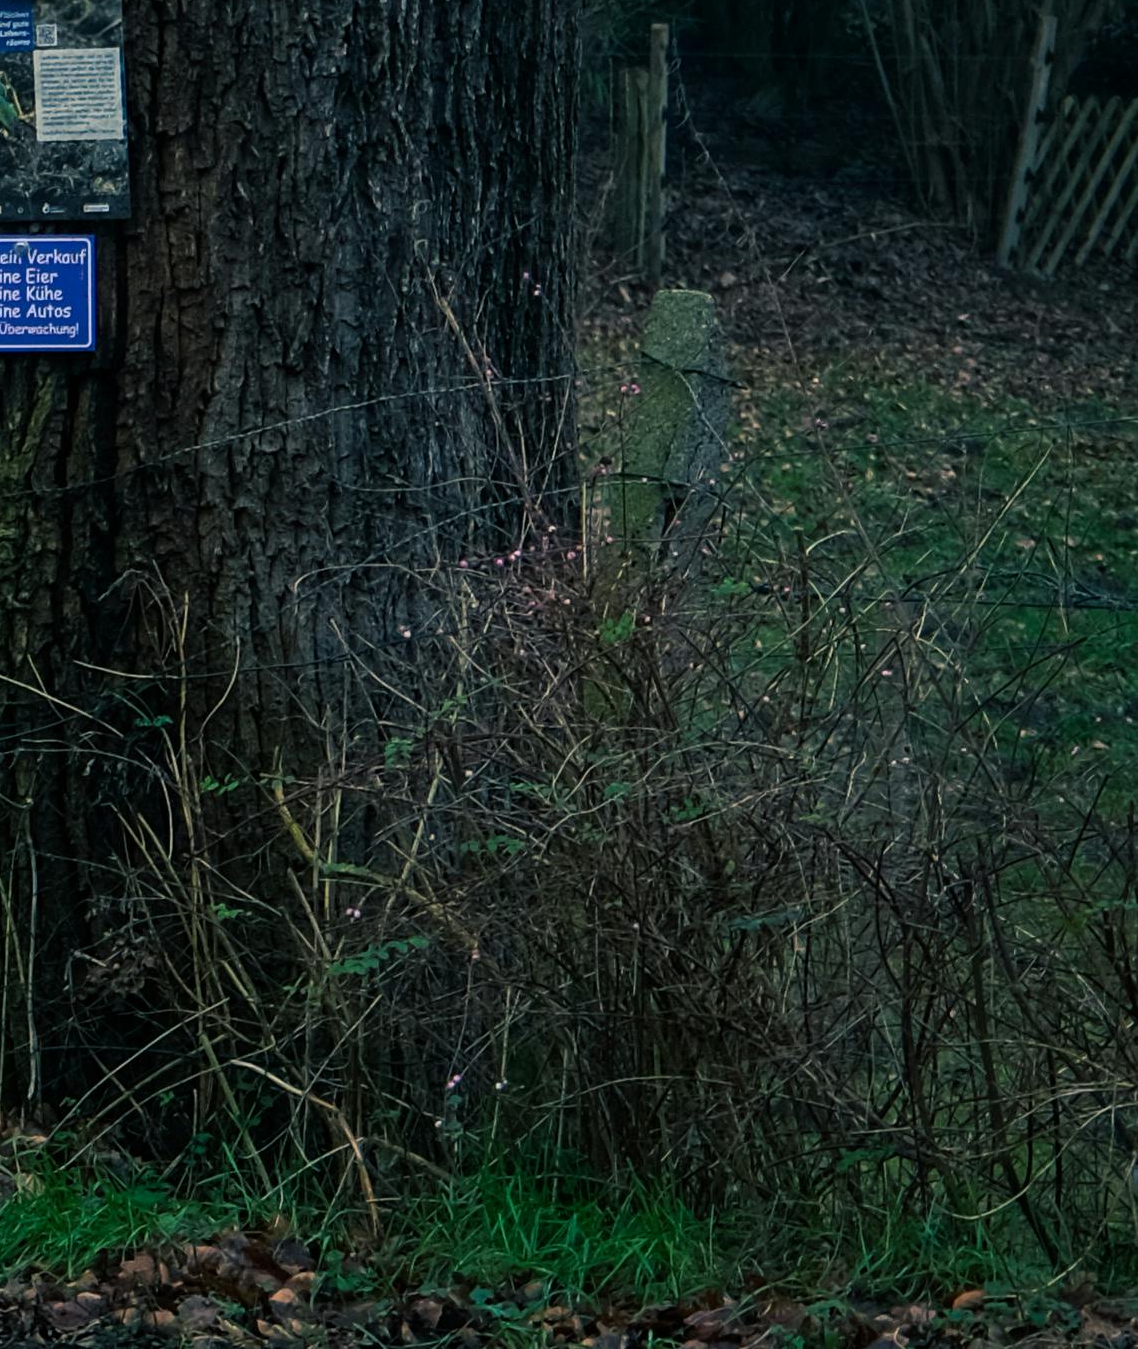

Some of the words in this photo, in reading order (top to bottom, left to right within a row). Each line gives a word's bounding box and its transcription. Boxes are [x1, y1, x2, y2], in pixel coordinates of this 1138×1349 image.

[28, 248, 87, 265] Verkauf
[26, 268, 58, 284] Eier
[26, 285, 63, 302] Kühe
[26, 304, 72, 319] Autos
